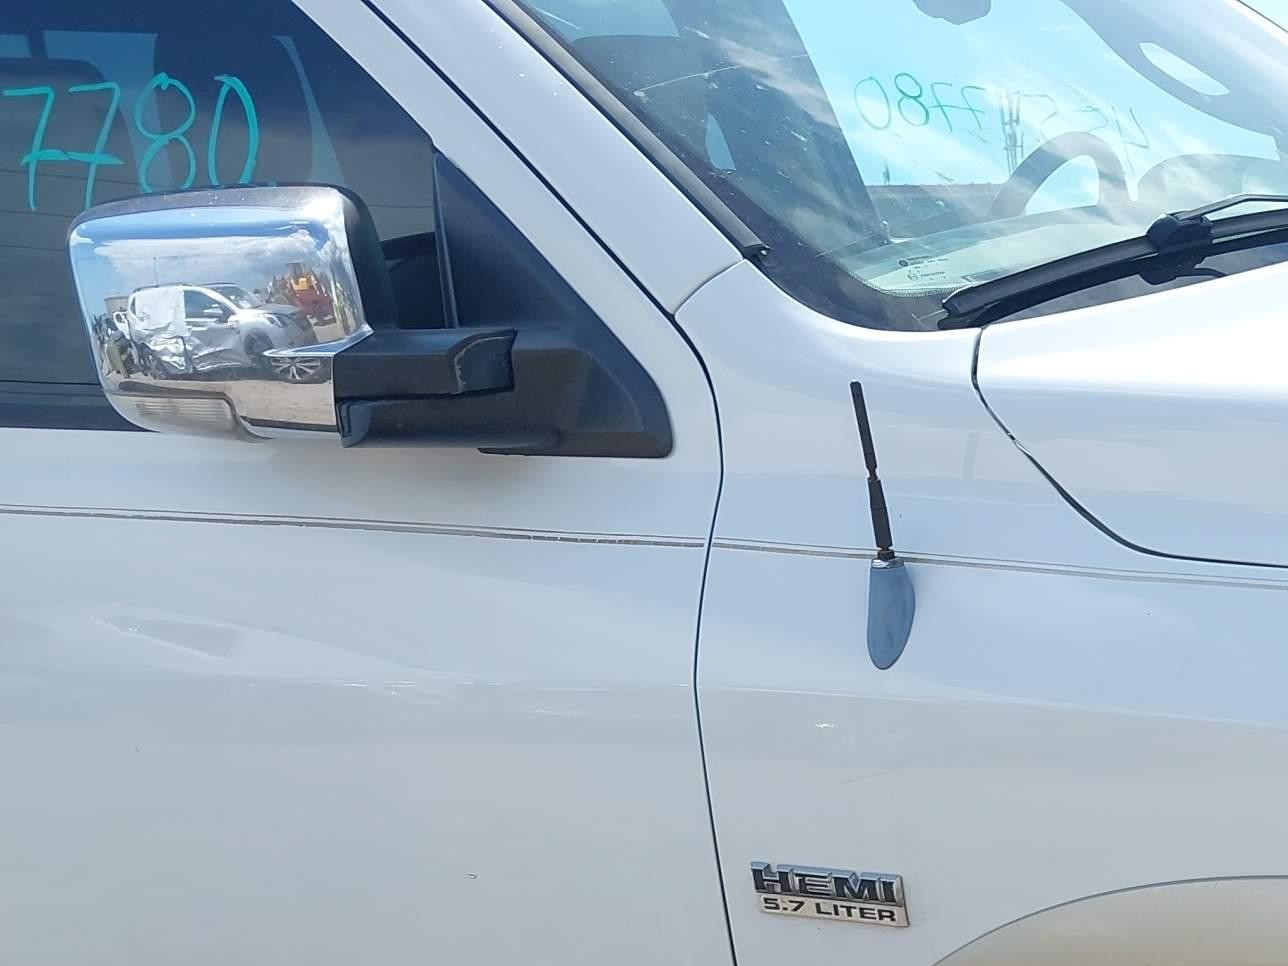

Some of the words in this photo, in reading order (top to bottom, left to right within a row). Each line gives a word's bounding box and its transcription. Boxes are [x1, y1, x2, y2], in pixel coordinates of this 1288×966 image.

[3, 72, 259, 211] 7780
[751, 861, 905, 907] HEMI
[762, 897, 806, 913] 5.7
[814, 901, 897, 923] LITER
